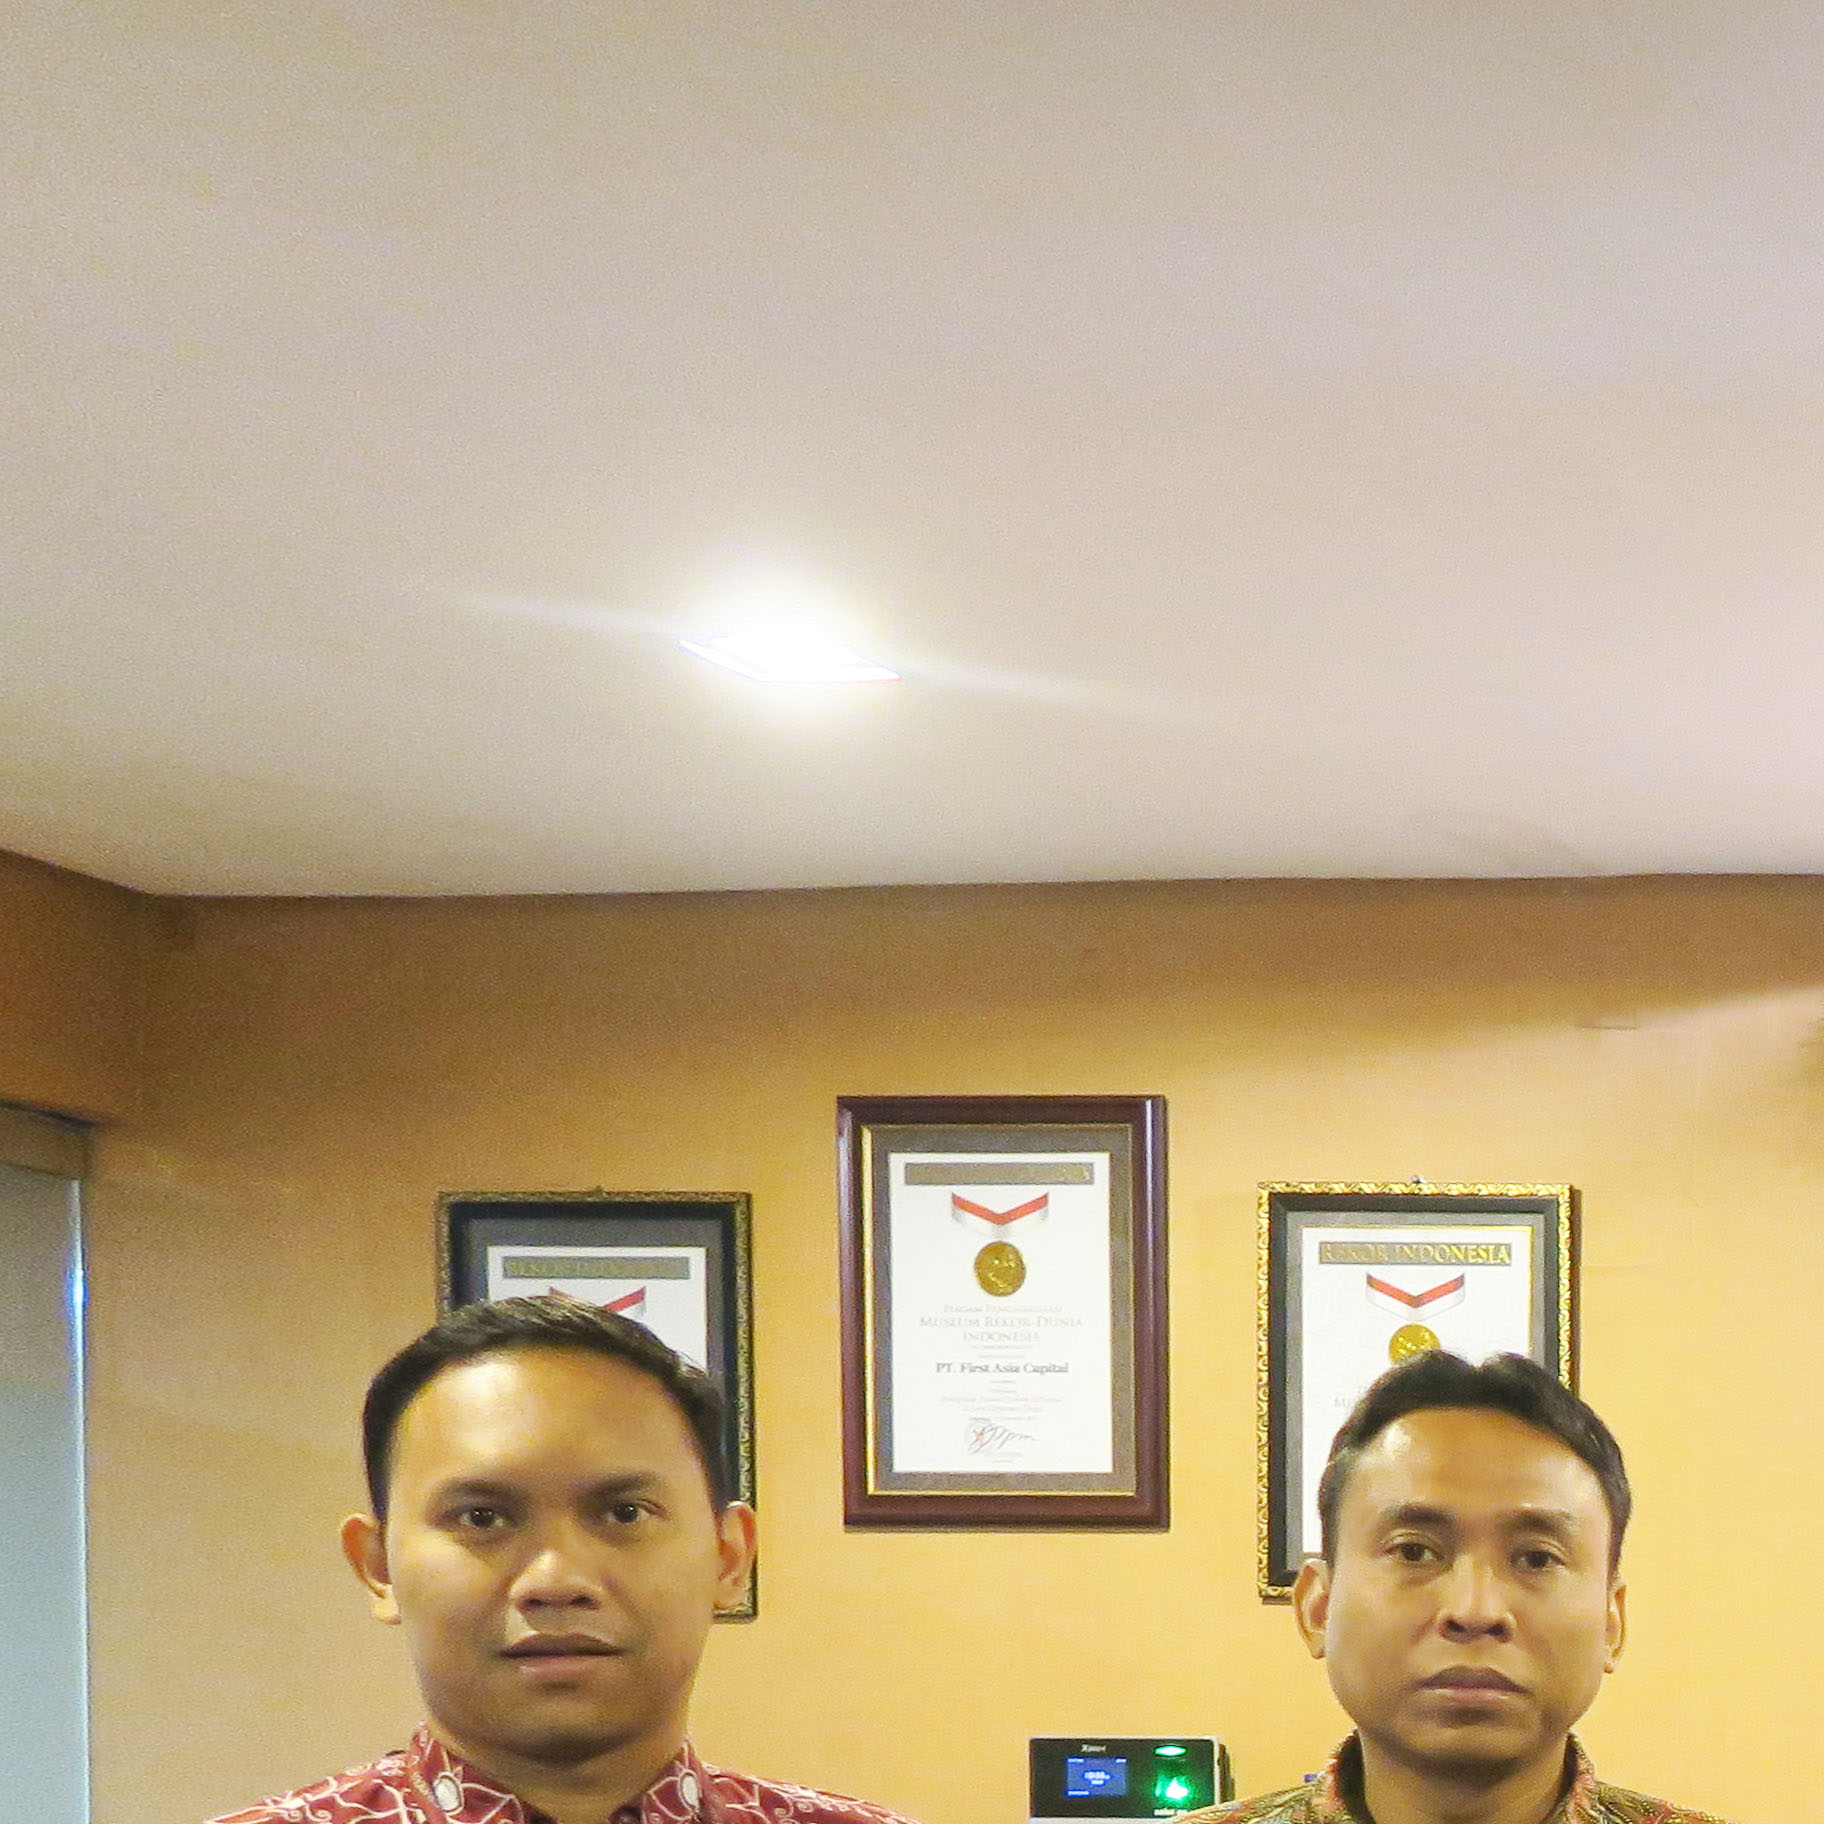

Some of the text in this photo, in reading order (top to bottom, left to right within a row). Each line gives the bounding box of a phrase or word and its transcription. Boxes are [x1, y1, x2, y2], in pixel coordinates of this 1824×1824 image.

[1394, 1243, 1511, 1264] INDONESIA
[919, 1316, 981, 1328] MUSEUM
[1036, 1316, 1083, 1328] DUNIA
[962, 1331, 1041, 1343] INDONESIA
[959, 1362, 989, 1374] First
[993, 1362, 1020, 1374] Asia
[1023, 1362, 1069, 1376] Capital
